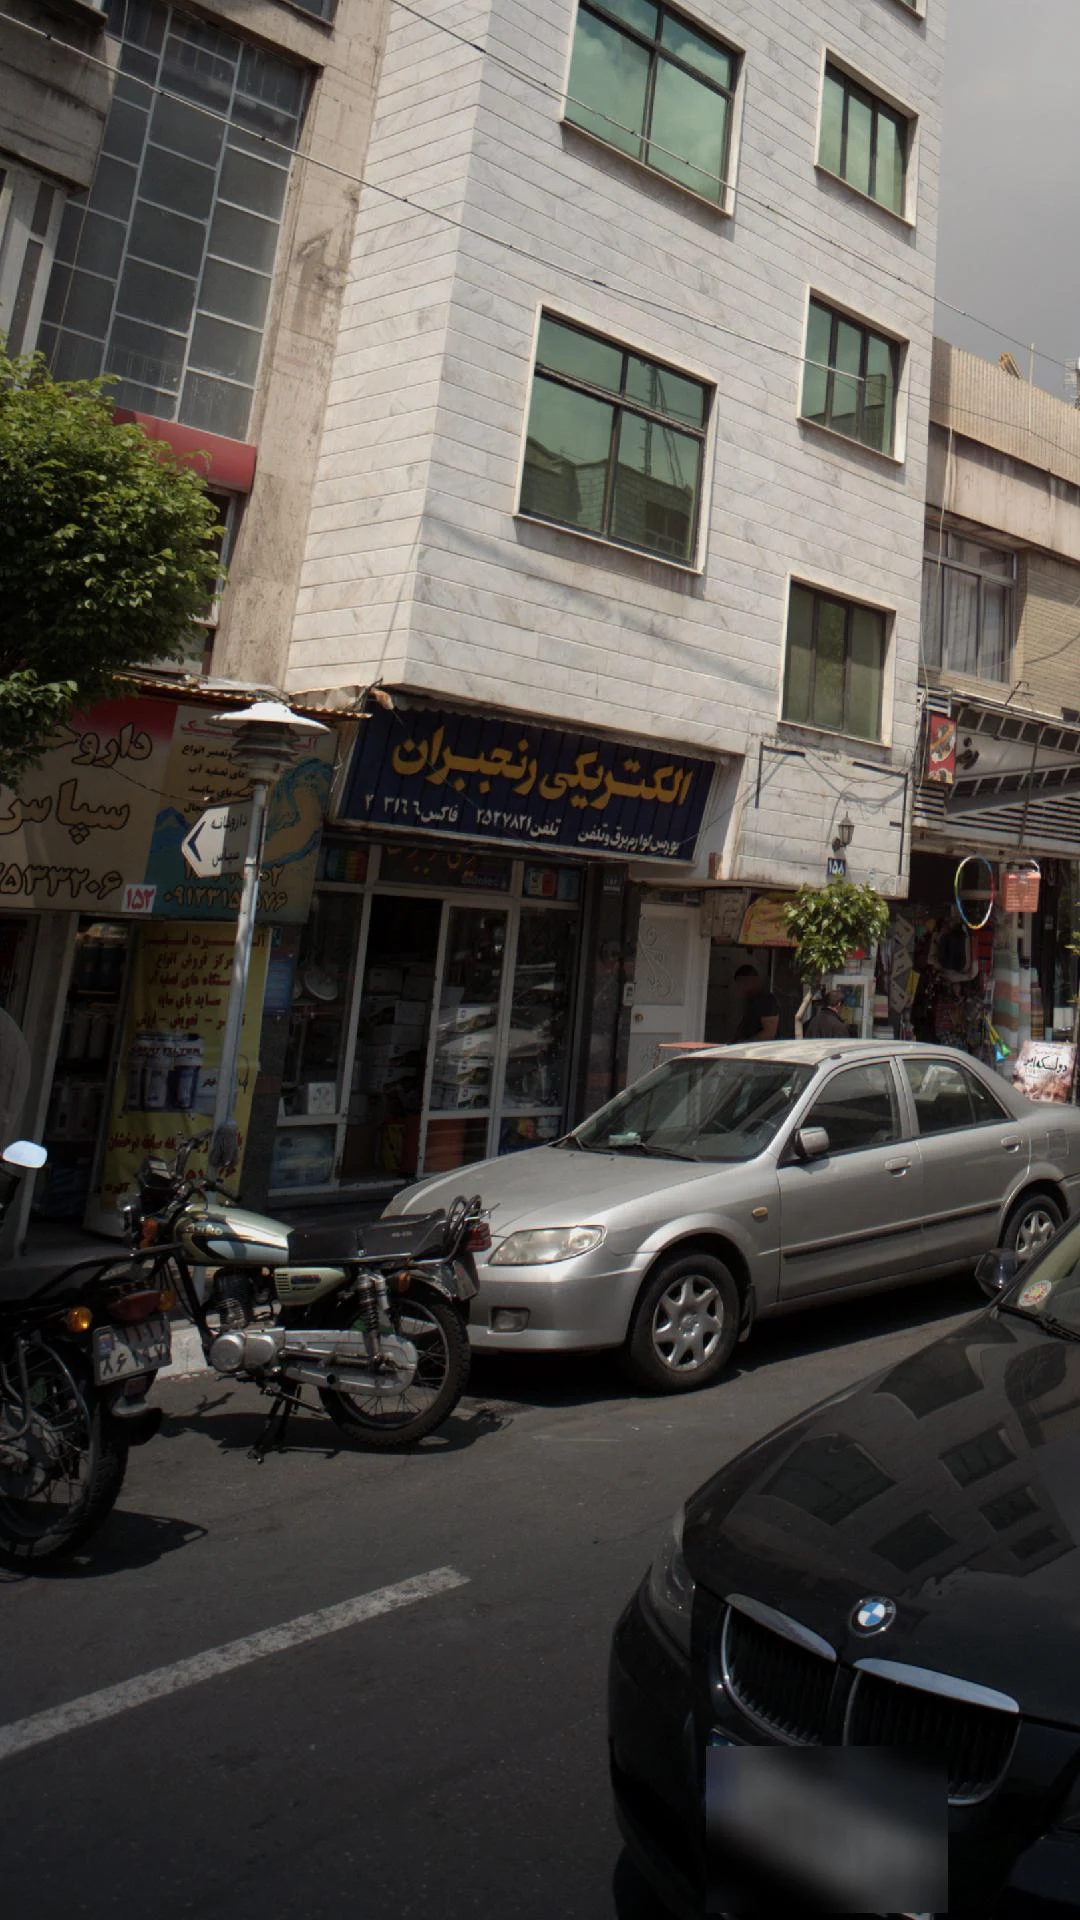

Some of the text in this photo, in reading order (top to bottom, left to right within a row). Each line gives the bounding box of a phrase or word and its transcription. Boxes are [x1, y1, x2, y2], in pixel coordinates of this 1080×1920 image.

[391, 724, 695, 810] الکتریکی رنجبران
[211, 813, 248, 832] داروخانه
[420, 803, 459, 823] فاکس
[530, 818, 562, 838] تلفن
[212, 847, 239, 868] سپاس
